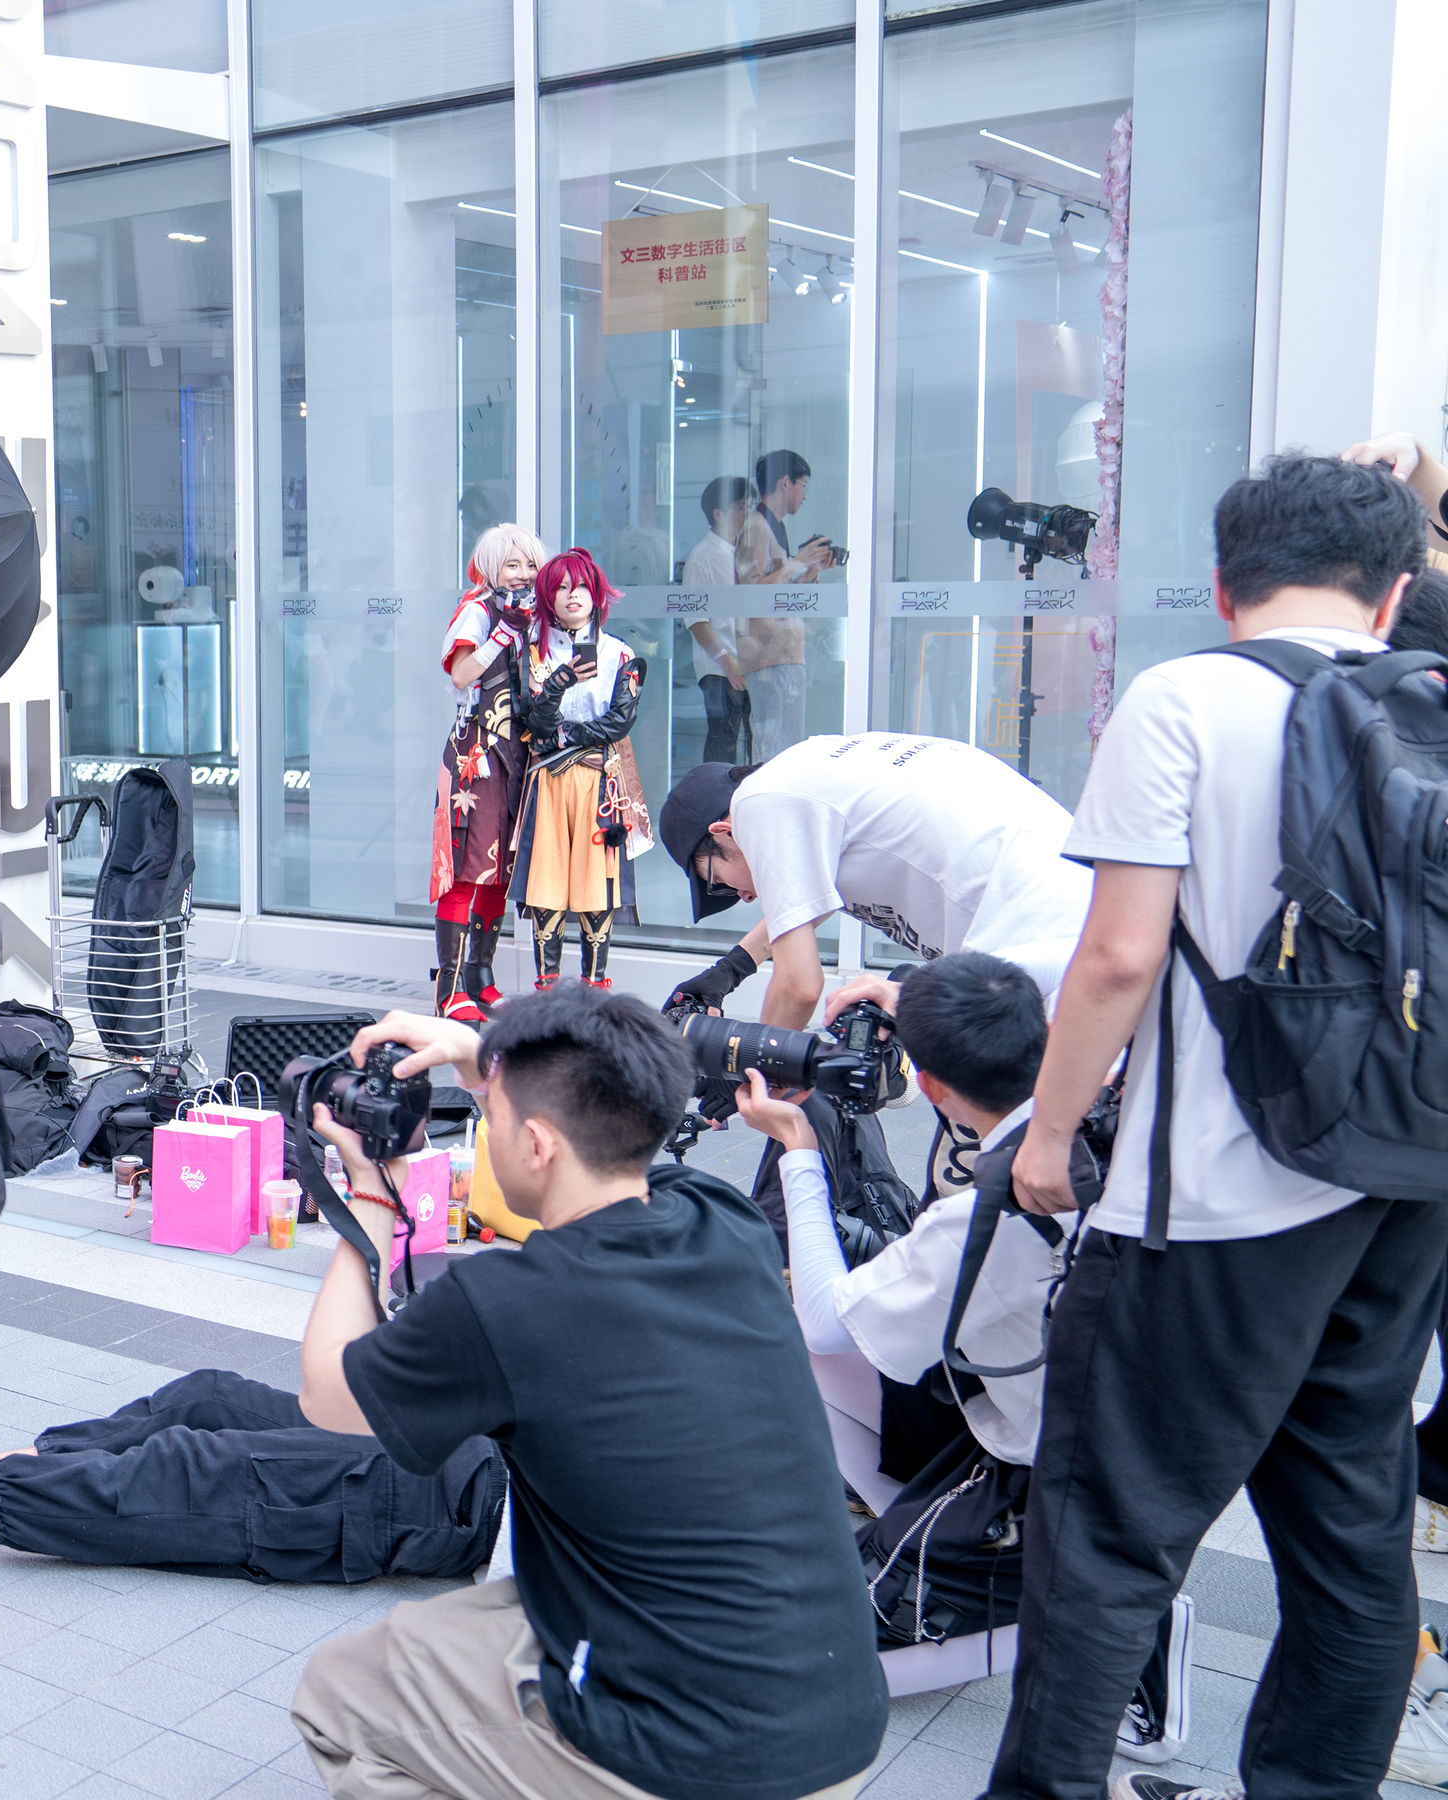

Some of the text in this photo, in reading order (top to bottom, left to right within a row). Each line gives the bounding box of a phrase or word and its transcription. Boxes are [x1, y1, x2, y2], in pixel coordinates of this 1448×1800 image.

[620, 236, 748, 264] 文三数字生活街区
[658, 263, 708, 284] 科普站
[667, 603, 709, 612] PARK
[774, 602, 819, 612] PARK
[902, 601, 949, 611] PARK
[1024, 600, 1076, 609] PARK
[1155, 598, 1211, 608] PARK
[283, 608, 316, 616] PARK
[368, 607, 402, 615] PARK
[180, 1166, 207, 1182] Barbie
